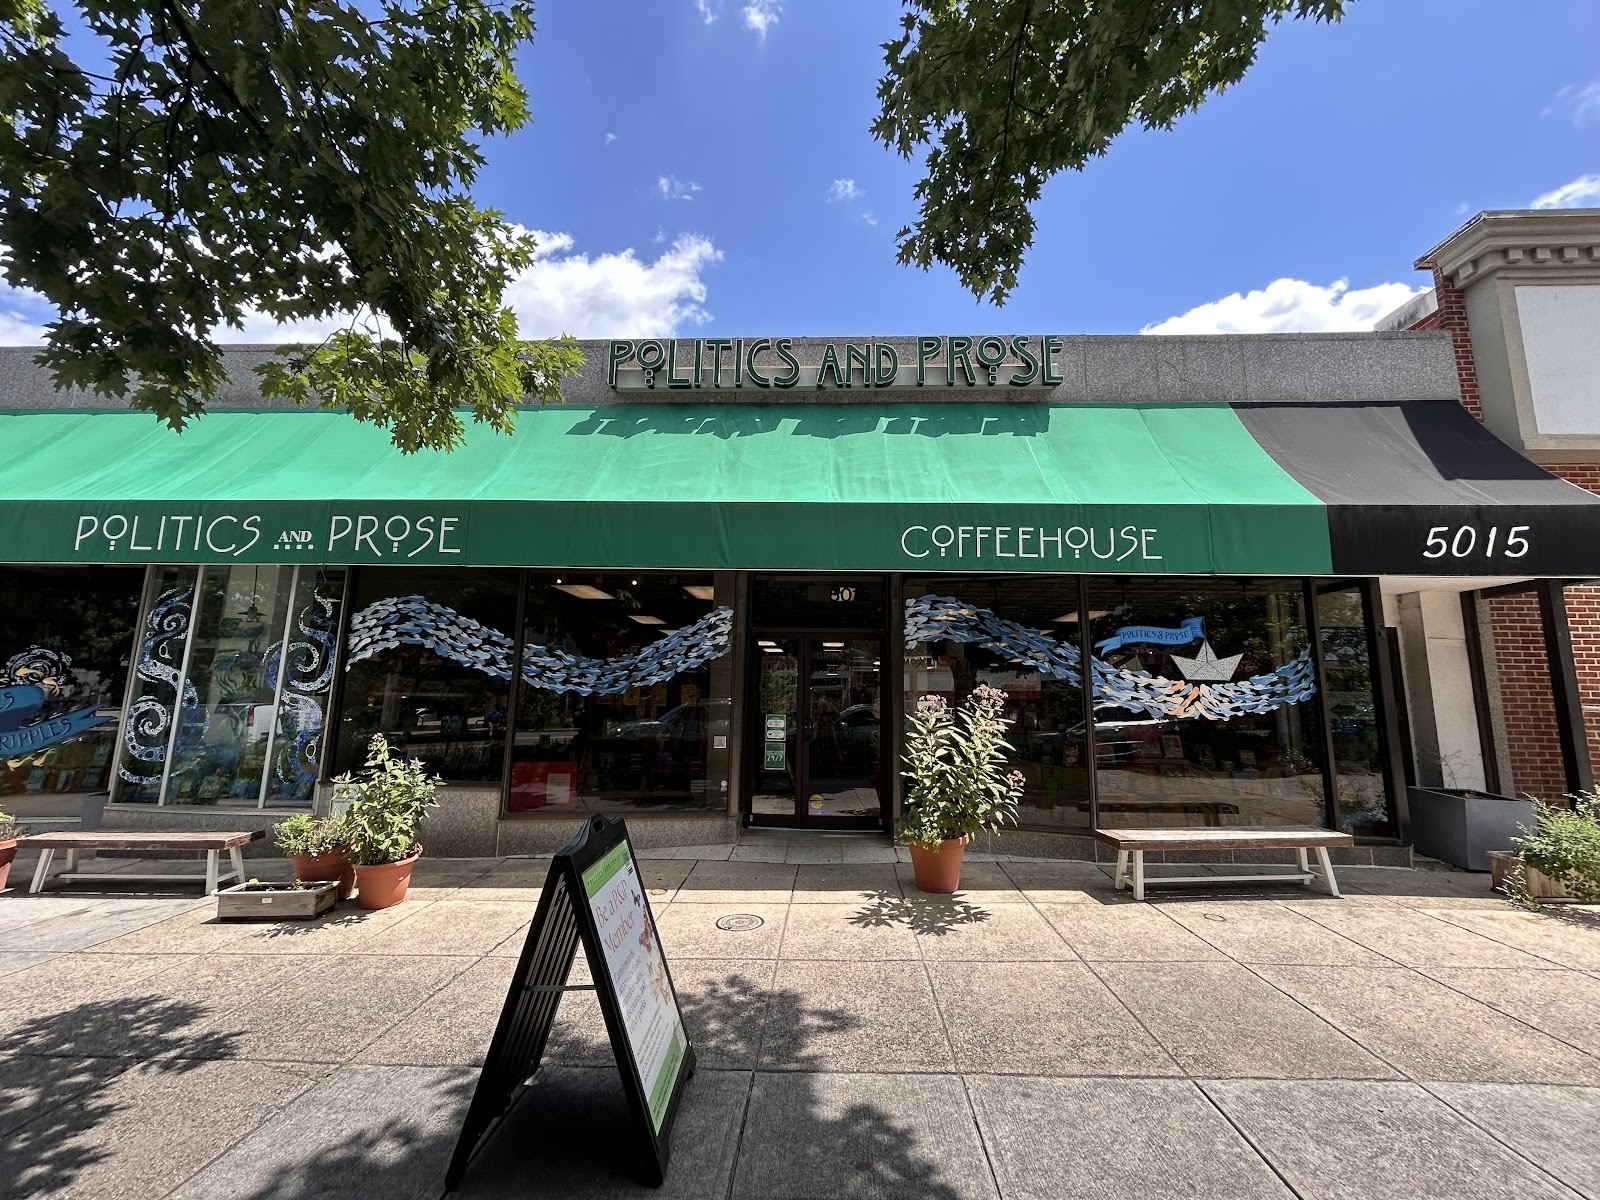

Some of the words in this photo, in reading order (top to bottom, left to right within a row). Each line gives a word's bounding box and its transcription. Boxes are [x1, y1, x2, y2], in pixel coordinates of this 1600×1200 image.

[607, 338, 800, 388] POLITICS
[816, 344, 898, 388] AND
[916, 335, 1064, 387] PROSE
[74, 514, 262, 557] POLITICS
[276, 530, 314, 545] AND
[328, 515, 461, 557] PROSE
[901, 525, 1163, 561] COFFEEHOUSE
[1422, 525, 1530, 559] 5015
[1122, 630, 1156, 640] POLITICS
[1157, 631, 1164, 640] &
[1165, 631, 1189, 641] PROSE
[0, 718, 72, 751] RIPPLES
[608, 900, 615, 916] a
[611, 879, 628, 910] P&P
[595, 906, 609, 928] Be
[603, 911, 635, 959] Member
